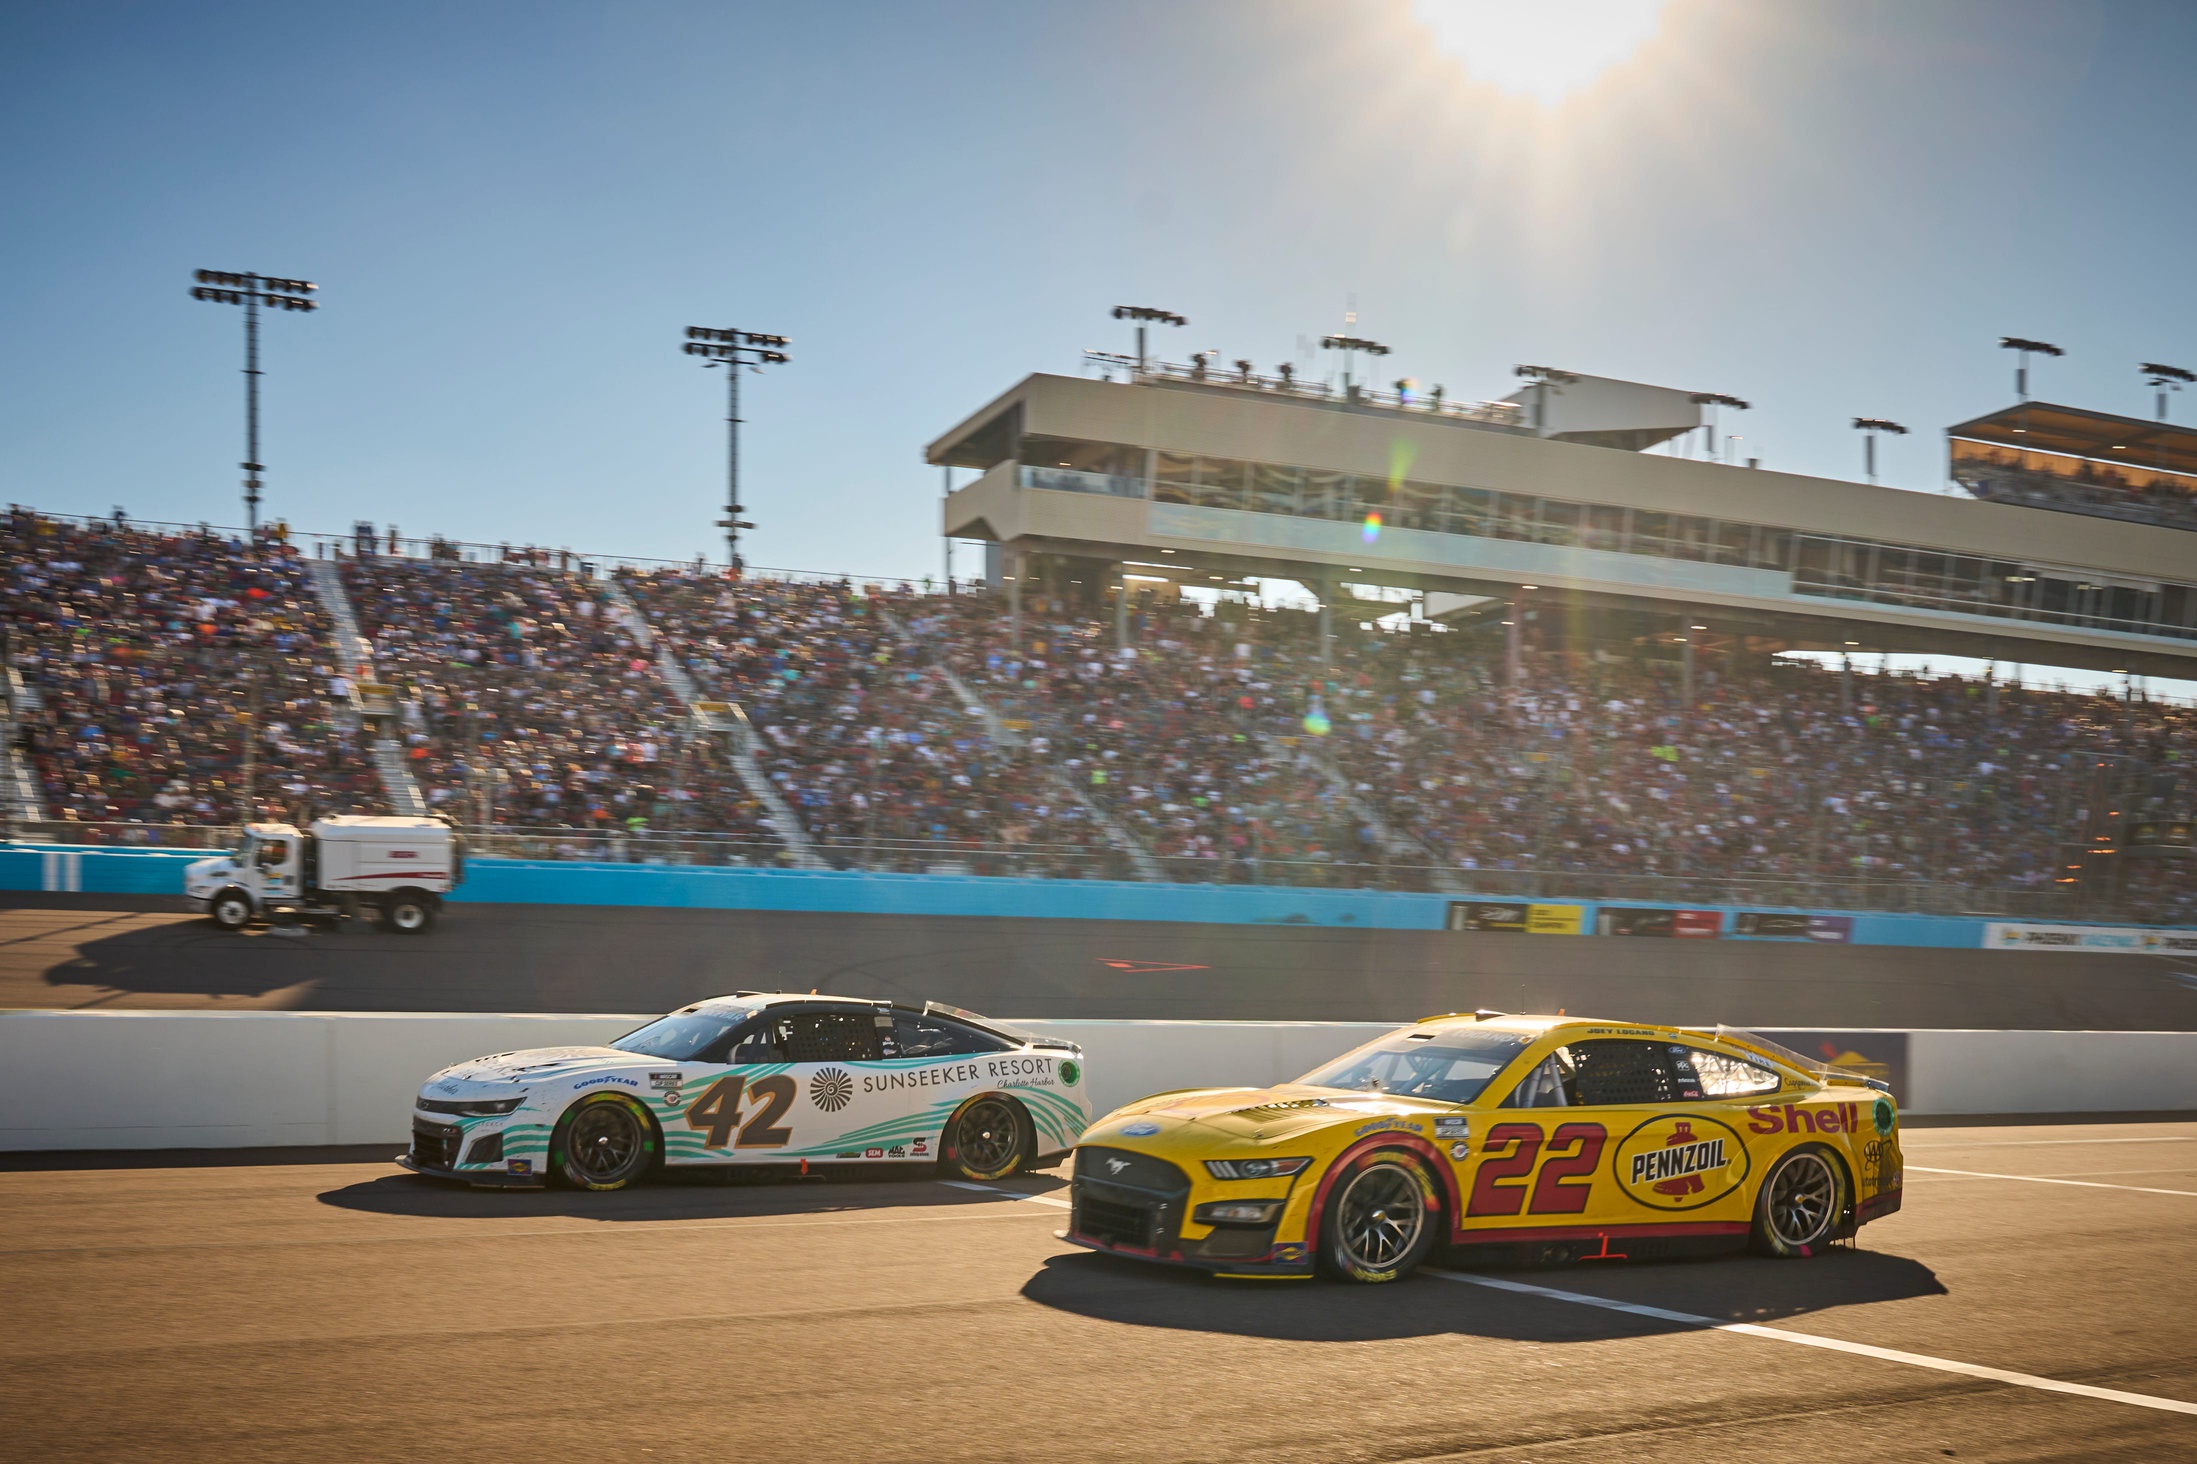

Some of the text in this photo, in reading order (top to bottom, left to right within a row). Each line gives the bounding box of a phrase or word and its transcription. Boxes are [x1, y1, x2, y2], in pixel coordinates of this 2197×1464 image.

[1453, 1029, 1517, 1042] LOGANO
[573, 1075, 639, 1090] GOODYEAR
[864, 1064, 980, 1093] SUNSEEKER
[989, 1058, 1053, 1077] RESORT
[997, 1078, 1055, 1089] Charlotte Harbor
[684, 1074, 798, 1150] 42
[1747, 1102, 1858, 1135] Shell
[1354, 1117, 1424, 1137] GOODYEAR
[867, 1149, 881, 1157] SEM
[1631, 1137, 1727, 1186] PENNZOIL
[1466, 1121, 1608, 1217] 22
